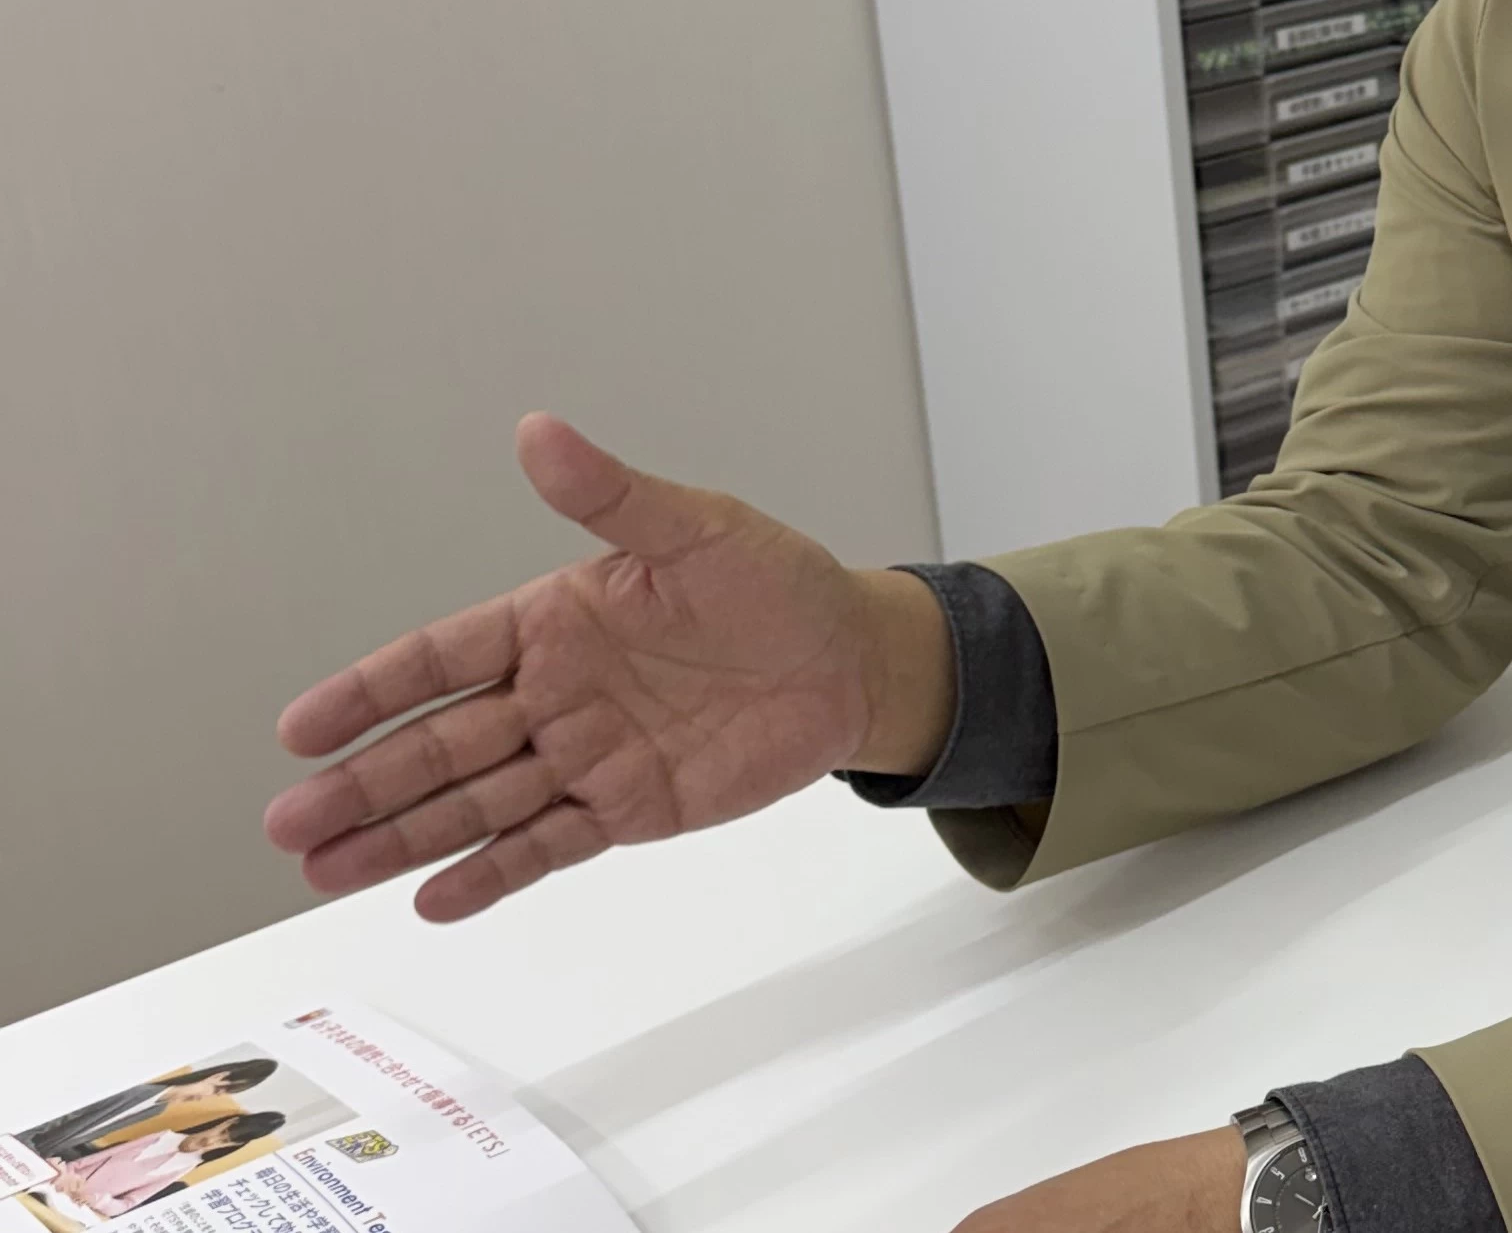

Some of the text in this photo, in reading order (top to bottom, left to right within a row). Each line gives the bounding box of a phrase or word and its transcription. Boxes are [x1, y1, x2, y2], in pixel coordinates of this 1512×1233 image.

[293, 1147, 394, 1233] Environment Te
[1270, 1167, 1285, 1180] 5
